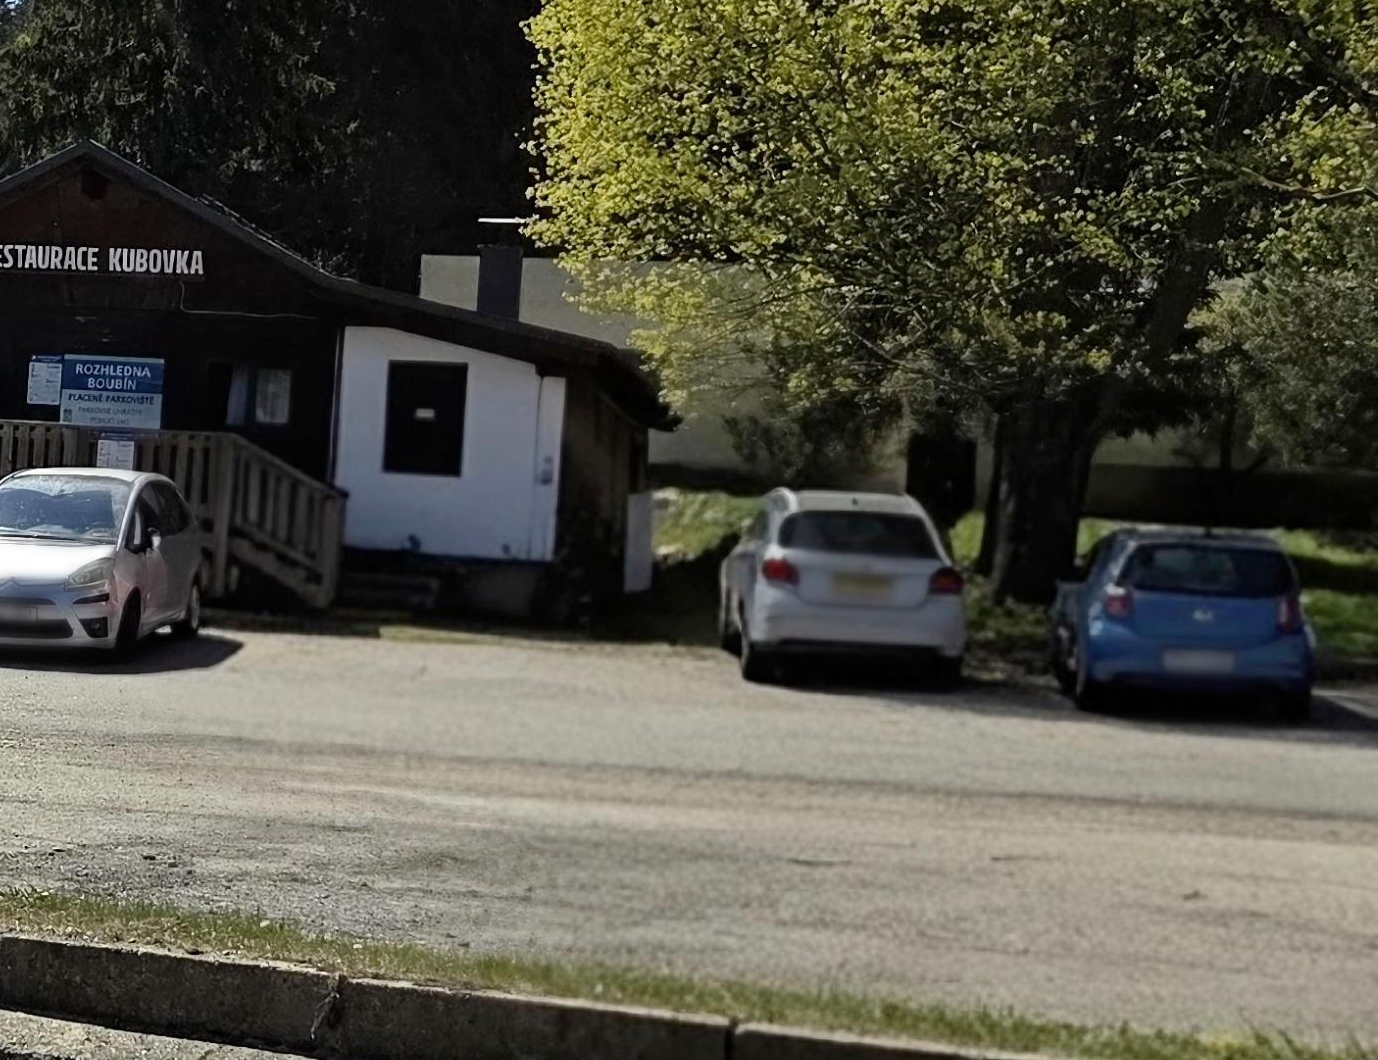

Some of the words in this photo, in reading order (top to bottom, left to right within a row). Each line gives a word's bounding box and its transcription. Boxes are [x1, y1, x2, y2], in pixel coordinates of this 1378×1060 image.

[108, 247, 204, 275] KUBOVKA
[75, 363, 151, 378] ROZHLEDNA
[87, 377, 137, 390] BOUBÍN
